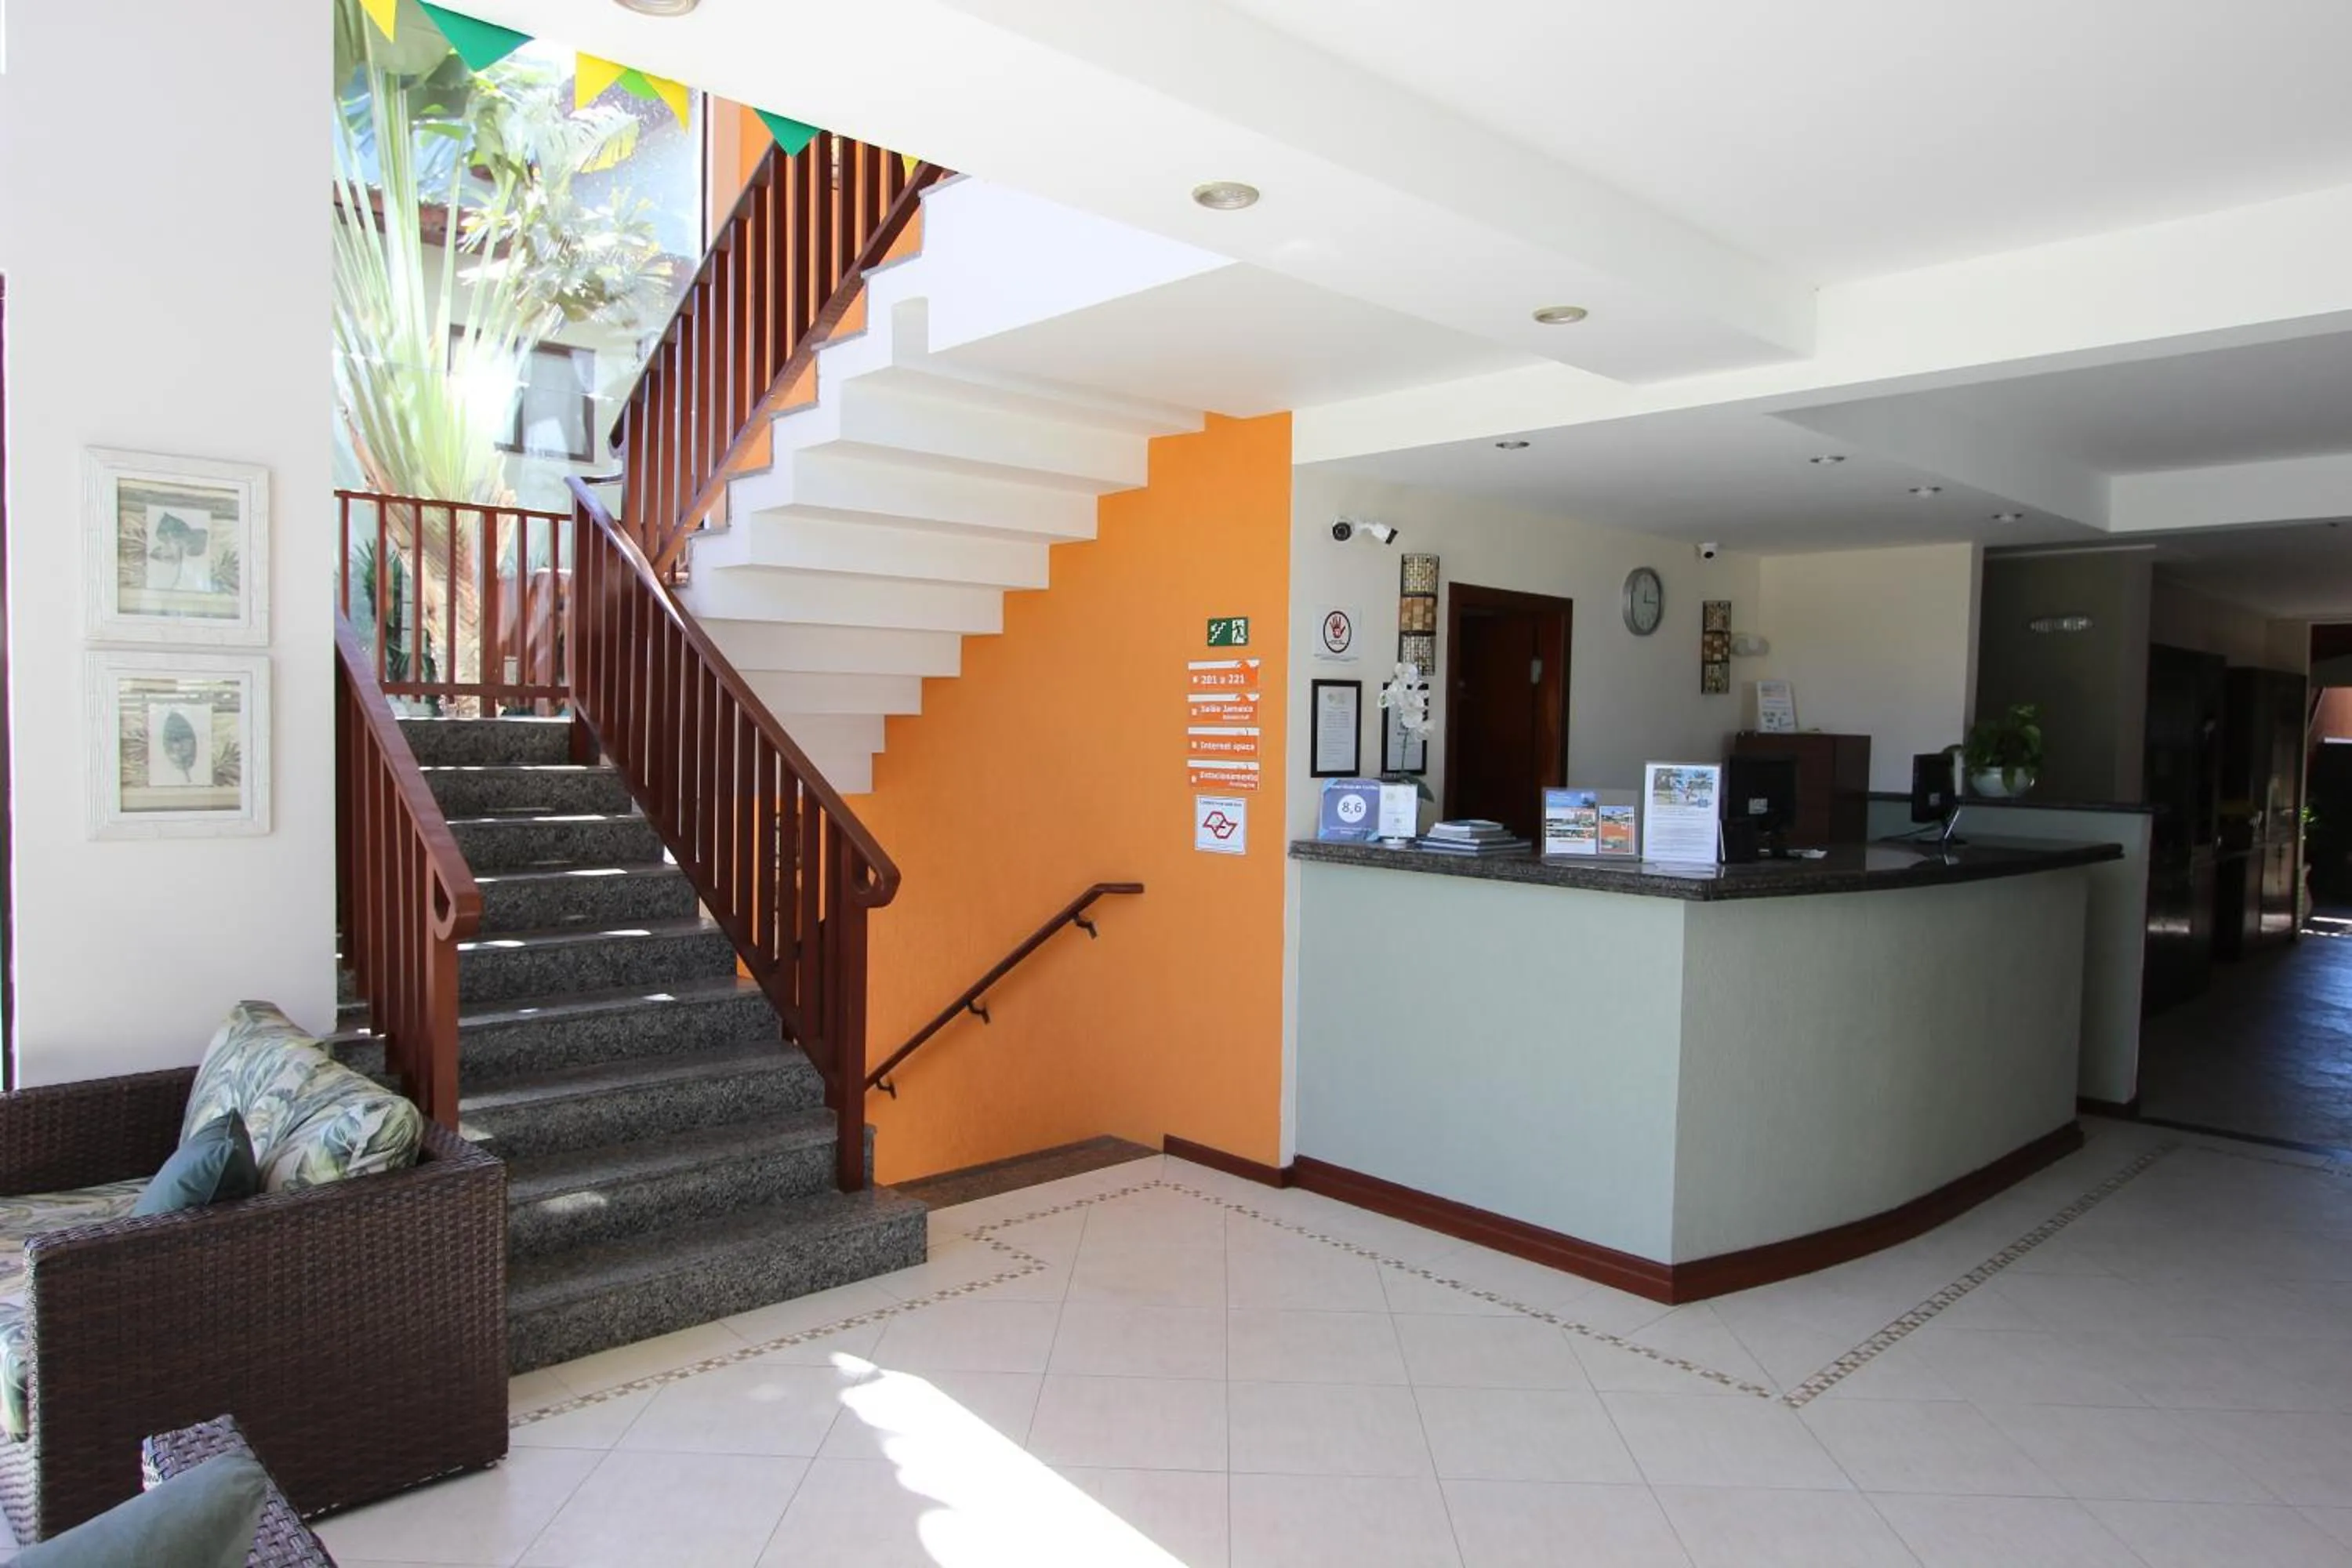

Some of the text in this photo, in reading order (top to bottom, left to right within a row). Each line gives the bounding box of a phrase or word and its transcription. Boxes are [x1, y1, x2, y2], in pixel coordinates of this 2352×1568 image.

[1200, 675, 1217, 684] 201
[1228, 673, 1244, 684] 221
[1200, 741, 1254, 752] Internet space
[1341, 801, 1362, 814] 8,6
